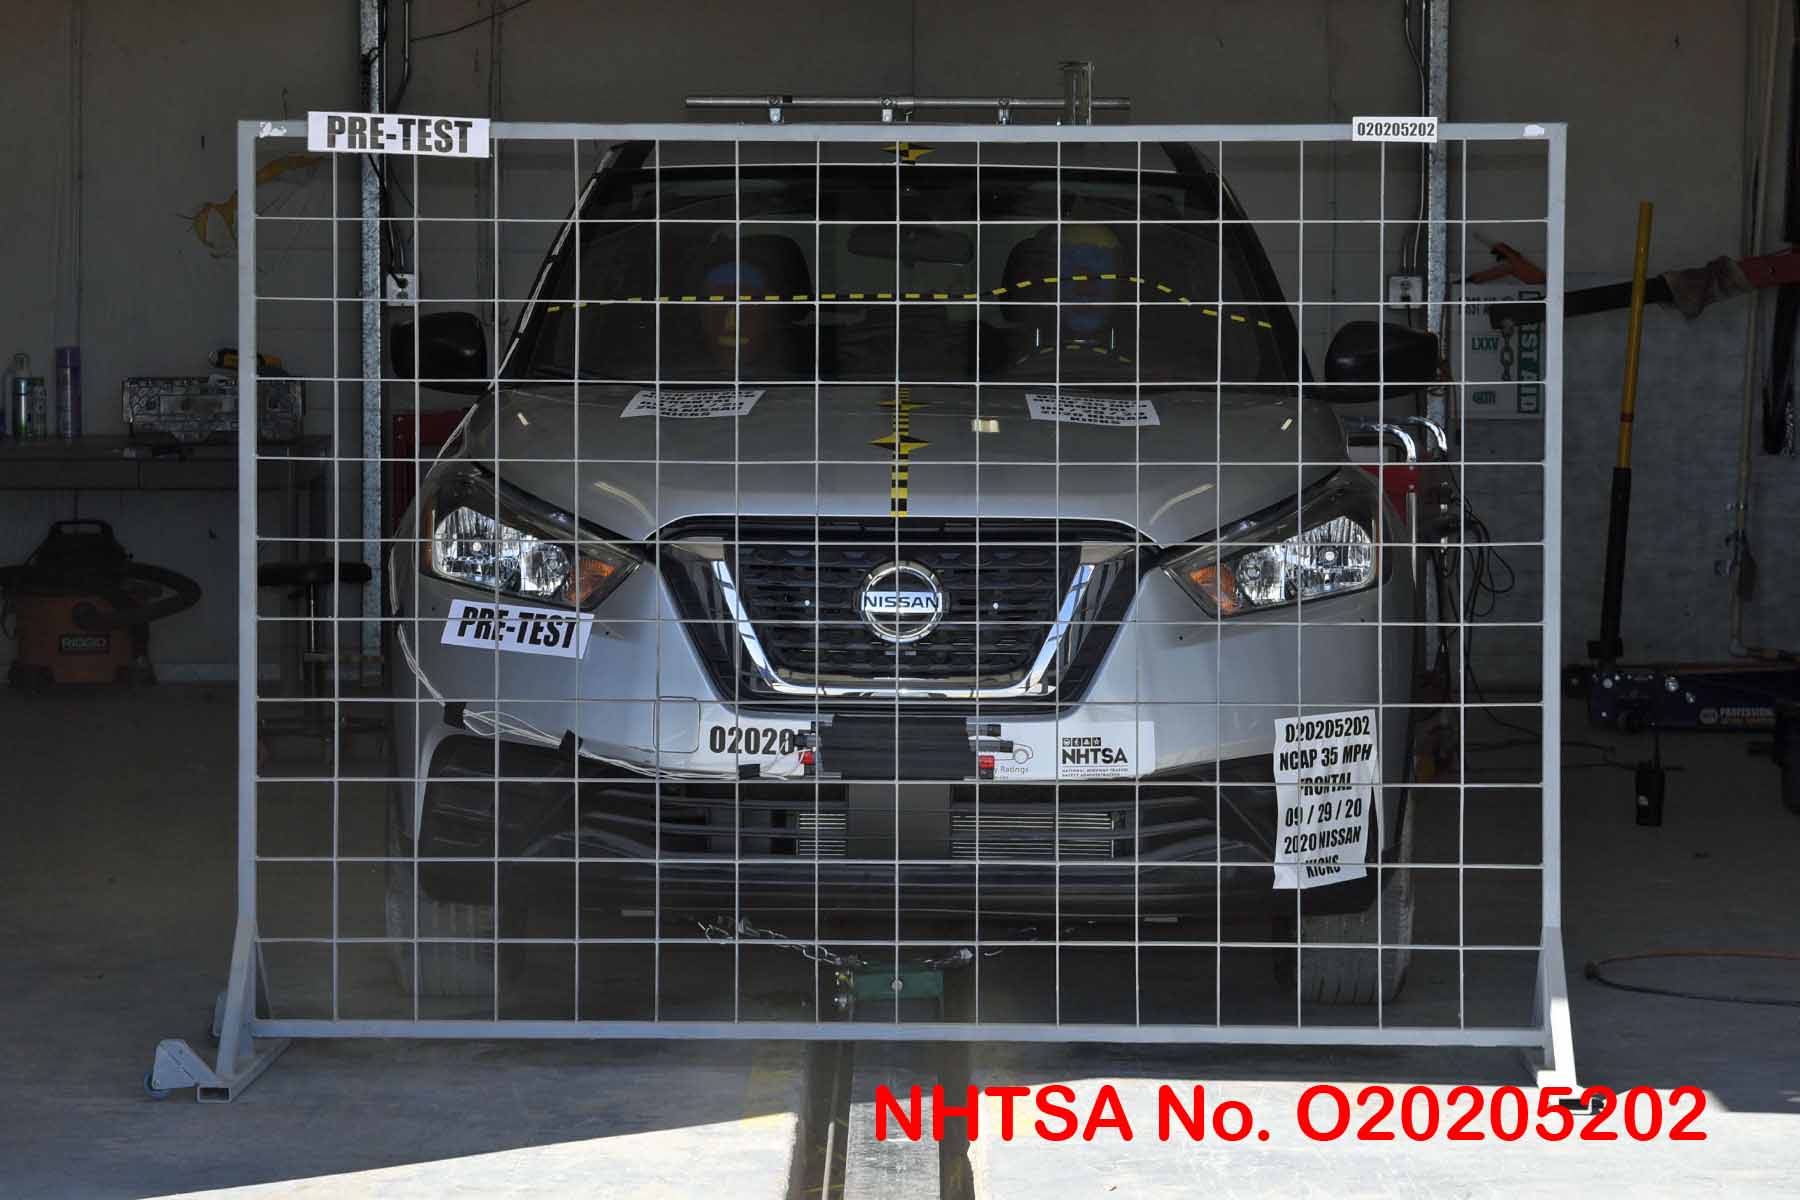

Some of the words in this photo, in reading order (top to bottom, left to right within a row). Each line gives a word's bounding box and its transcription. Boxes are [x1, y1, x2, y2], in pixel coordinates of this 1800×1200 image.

[327, 115, 473, 153] PRE-TEST
[864, 595, 939, 609] NISSAN
[457, 606, 578, 649] PRE-TEST
[1062, 747, 1128, 765] NHTSA
[1280, 749, 1318, 771] NCAP
[1321, 747, 1338, 767] 35
[1343, 744, 1373, 765] MPH
[1285, 806, 1303, 827] 09
[1317, 801, 1333, 823] 29
[1345, 798, 1362, 819] 20
[1284, 833, 1317, 855] 2020
[1319, 825, 1361, 849] NISSAN
[1305, 854, 1341, 878] KICKS
